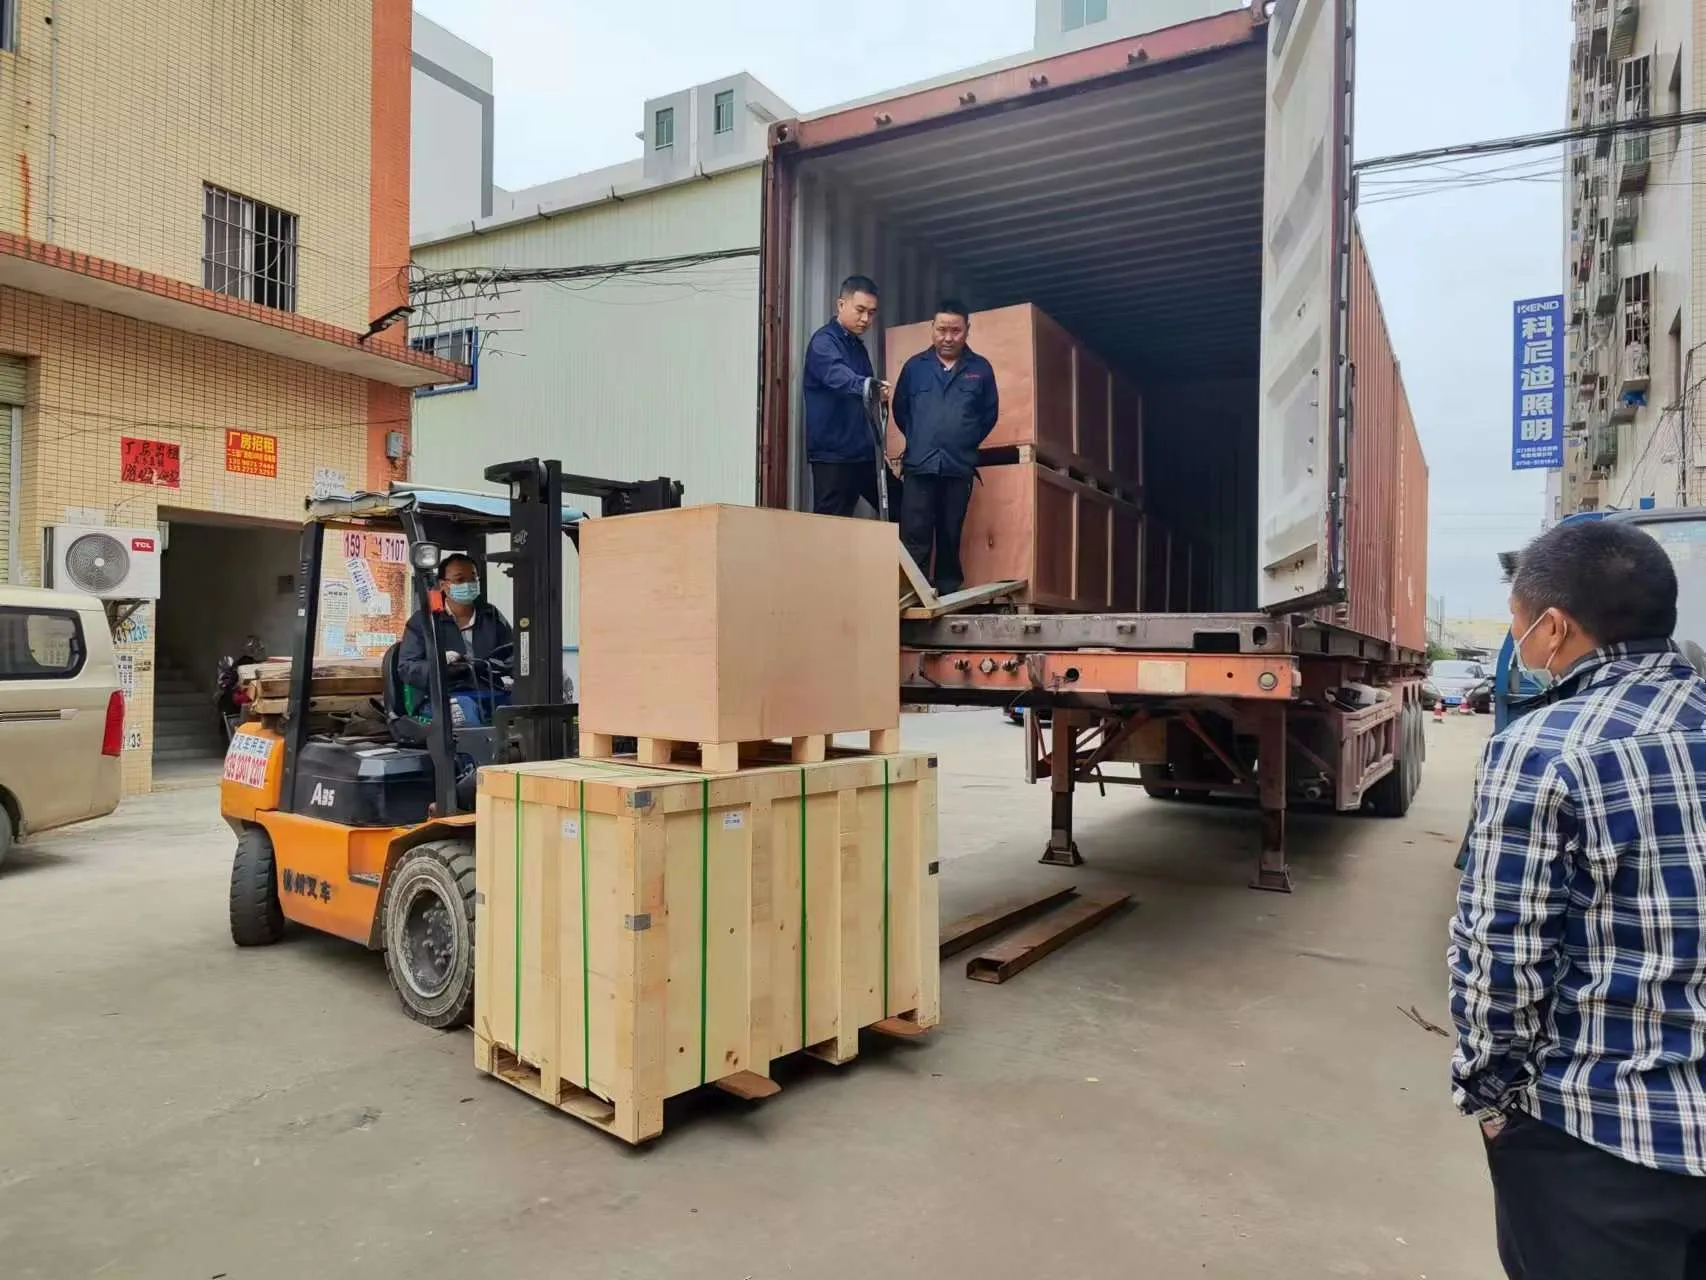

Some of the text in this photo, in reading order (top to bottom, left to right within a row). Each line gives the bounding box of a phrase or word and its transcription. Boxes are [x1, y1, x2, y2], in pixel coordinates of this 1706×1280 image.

[1521, 316, 1554, 441] 科尼迪照明
[229, 432, 274, 453] 厂房招租
[134, 541, 152, 549] TCL
[345, 533, 360, 558] 159
[386, 538, 405, 561] 7107
[310, 782, 335, 807] A35
